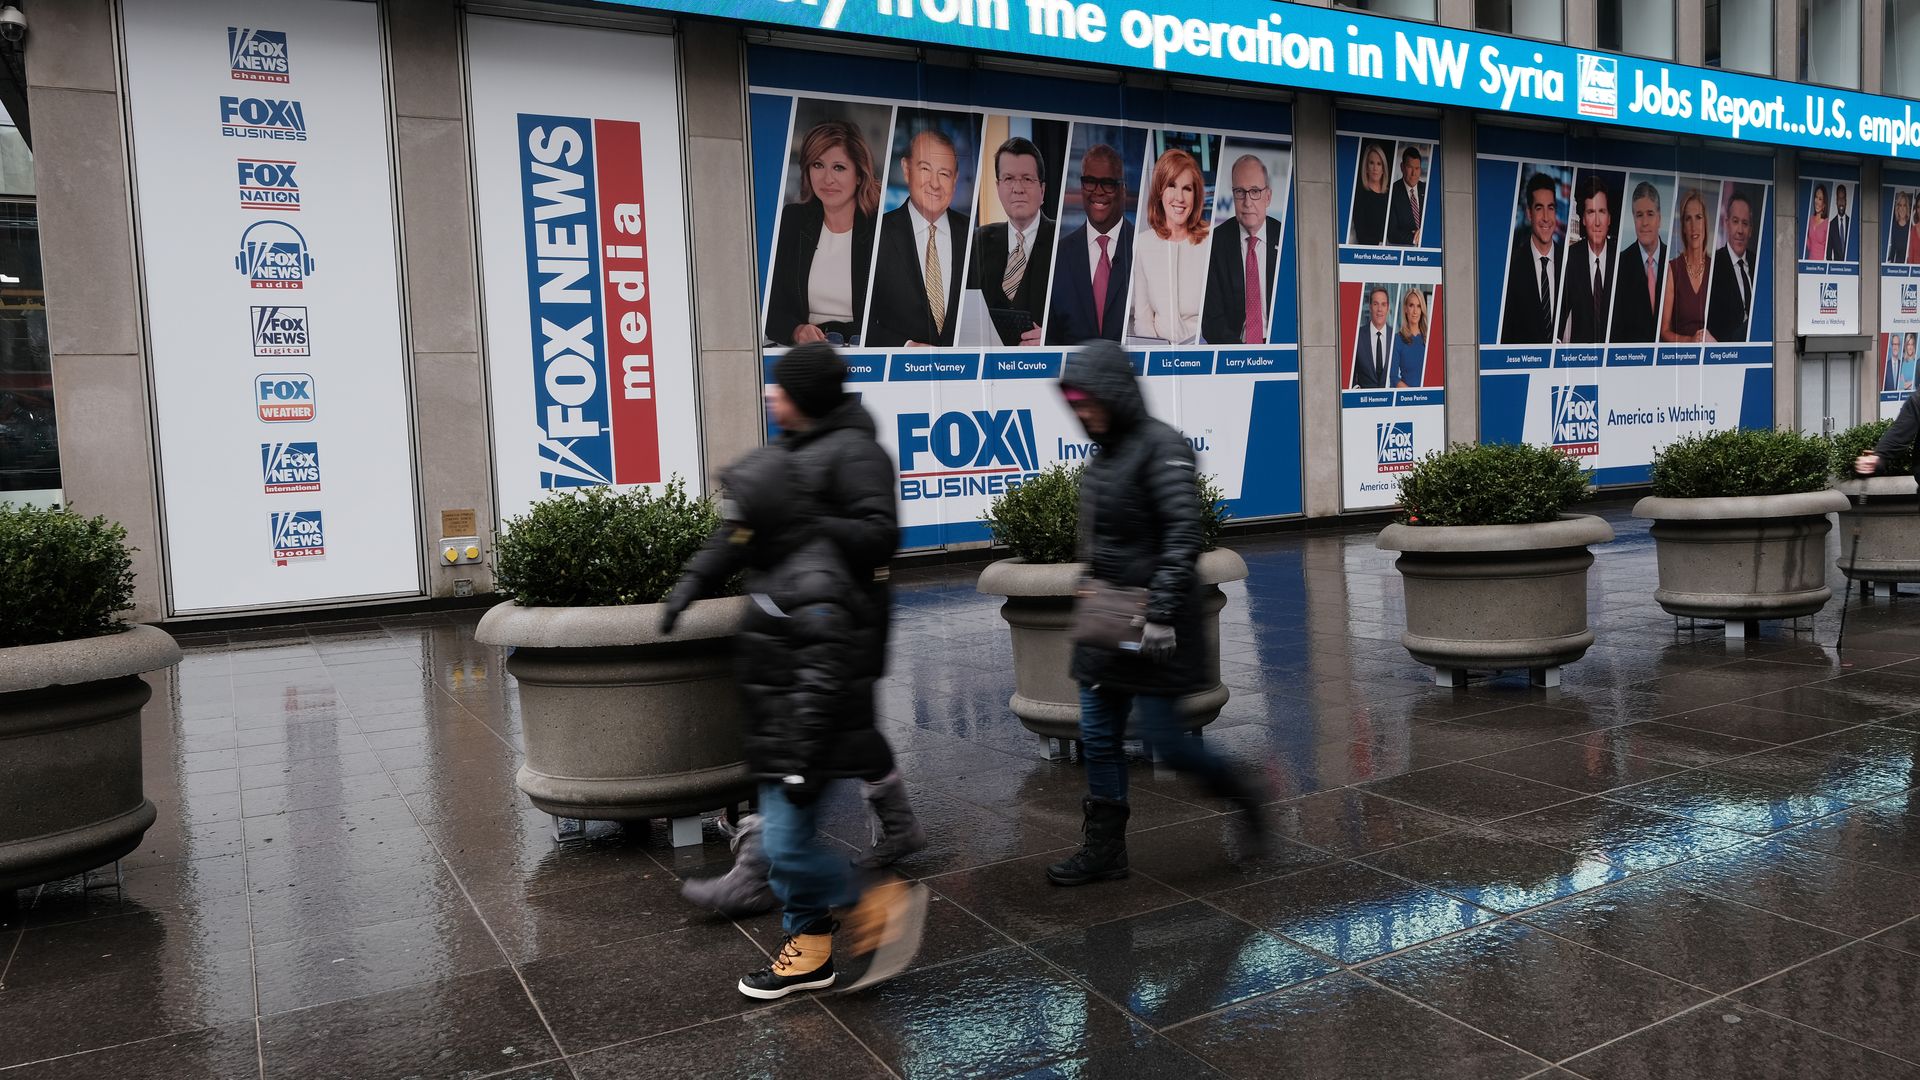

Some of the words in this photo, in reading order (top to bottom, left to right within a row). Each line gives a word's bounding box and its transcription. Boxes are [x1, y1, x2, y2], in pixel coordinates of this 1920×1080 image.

[248, 40, 285, 57] FOX
[238, 55, 287, 73] NEWS
[1120, 9, 1334, 70] operation
[1346, 25, 1383, 79] in
[1395, 31, 1470, 90] NW
[1479, 45, 1564, 111] Syria
[233, 72, 288, 82] channel
[1628, 68, 1692, 118] Jobs
[219, 95, 292, 127] FOX
[222, 126, 307, 142] BUSINESS
[237, 162, 298, 188] FOX
[240, 190, 300, 203] NATION
[528, 125, 592, 304] NEWS
[265, 252, 298, 267] FOX
[257, 265, 301, 280] NEWS
[255, 280, 299, 289] audio
[606, 202, 652, 400] media
[1825, 290, 1837, 298] FOX
[1823, 299, 1837, 307] NEWS
[271, 318, 304, 332] FOX
[262, 332, 306, 345] NEWS
[260, 347, 305, 355] digital
[1578, 353, 1598, 361] Carlson
[1628, 353, 1647, 362] Hannity
[1710, 352, 1721, 360] Greg
[998, 362, 1016, 370] Neil
[1017, 361, 1047, 370] Cavuto
[1162, 359, 1172, 368] Liz
[1226, 358, 1245, 368] Larry
[1246, 357, 1274, 366] Kudlow
[1506, 355, 1521, 363] Jesse
[846, 365, 872, 374] romo
[904, 362, 933, 372] Stuart
[934, 362, 966, 374] Varney
[541, 316, 600, 440] FOX
[260, 381, 310, 400] FOX
[262, 407, 311, 418] WEATHER
[1568, 401, 1597, 421] FOX
[1607, 408, 1653, 426] America
[1657, 407, 1665, 423] is
[1668, 404, 1716, 425] Watching
[1558, 422, 1598, 442] NEWS
[897, 410, 1017, 471] FOX
[1389, 433, 1412, 448] FOX
[1057, 437, 1101, 460] Inve
[1383, 447, 1413, 462] NEWS
[281, 452, 317, 468] FOX
[271, 468, 318, 483] NEWS
[1360, 481, 1389, 492] America
[1391, 480, 1397, 490] is
[289, 520, 321, 534] FOX
[280, 533, 322, 548] NEWS
[276, 548, 323, 558] books
